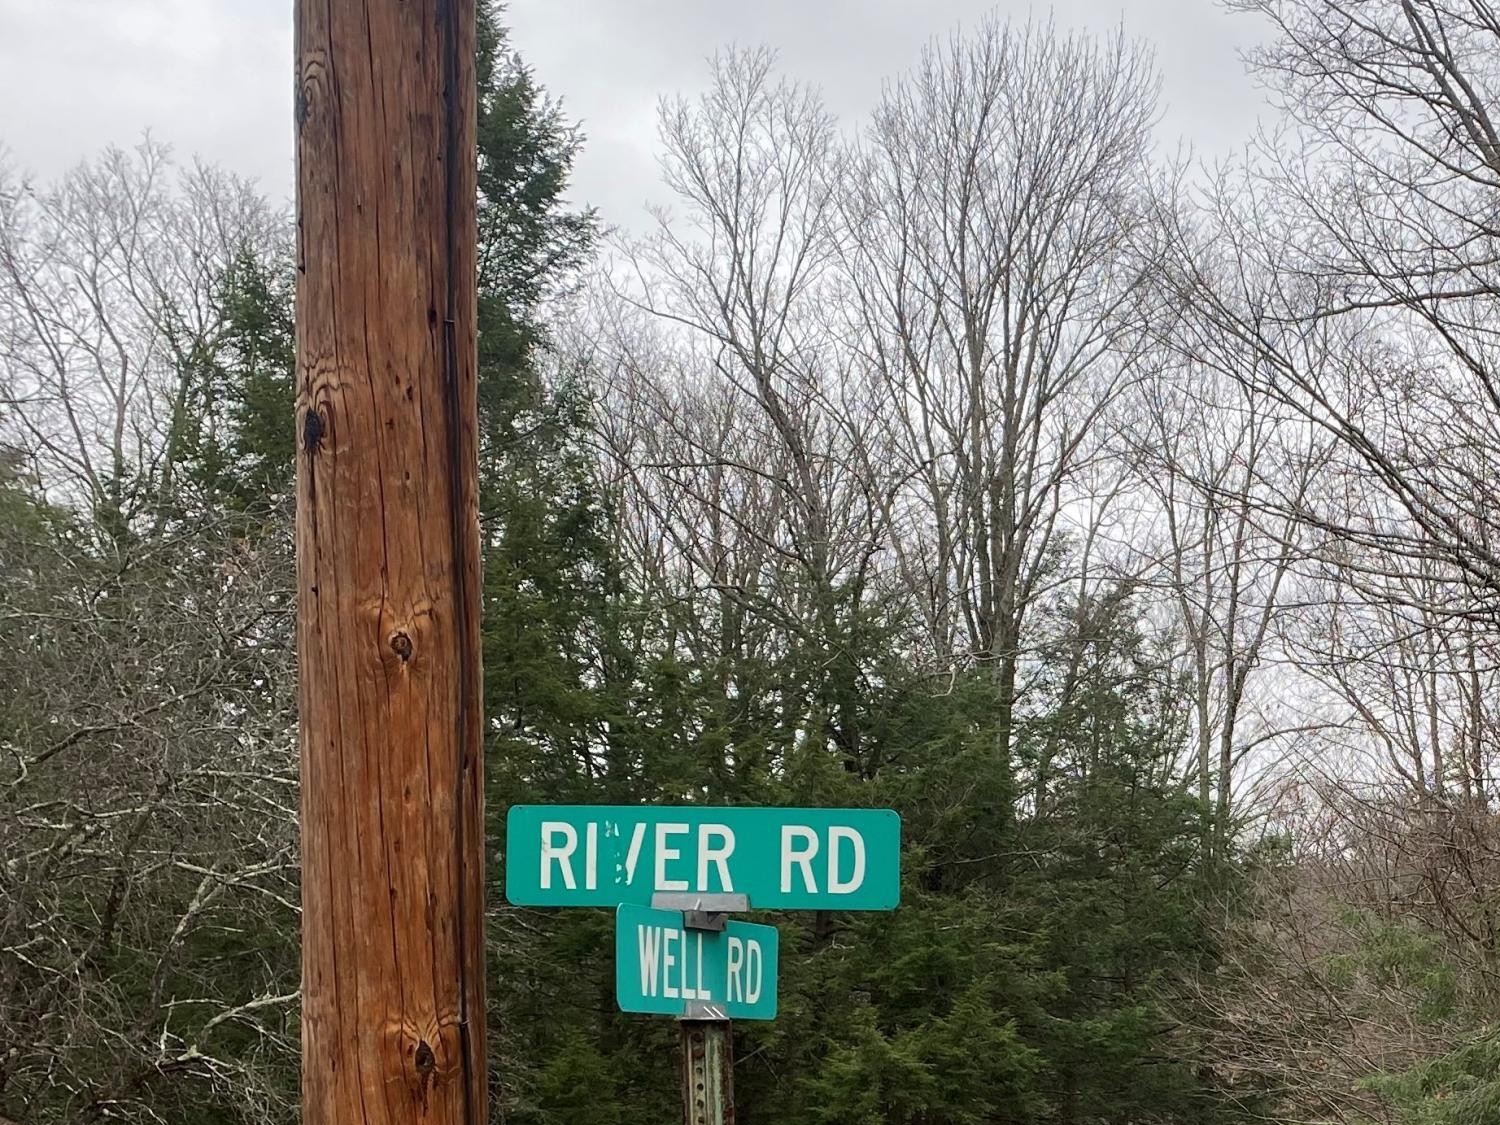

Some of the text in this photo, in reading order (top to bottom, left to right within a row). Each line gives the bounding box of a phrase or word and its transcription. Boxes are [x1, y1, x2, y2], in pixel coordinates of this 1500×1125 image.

[779, 824, 867, 895] RD
[637, 924, 763, 1004] WELL RD
